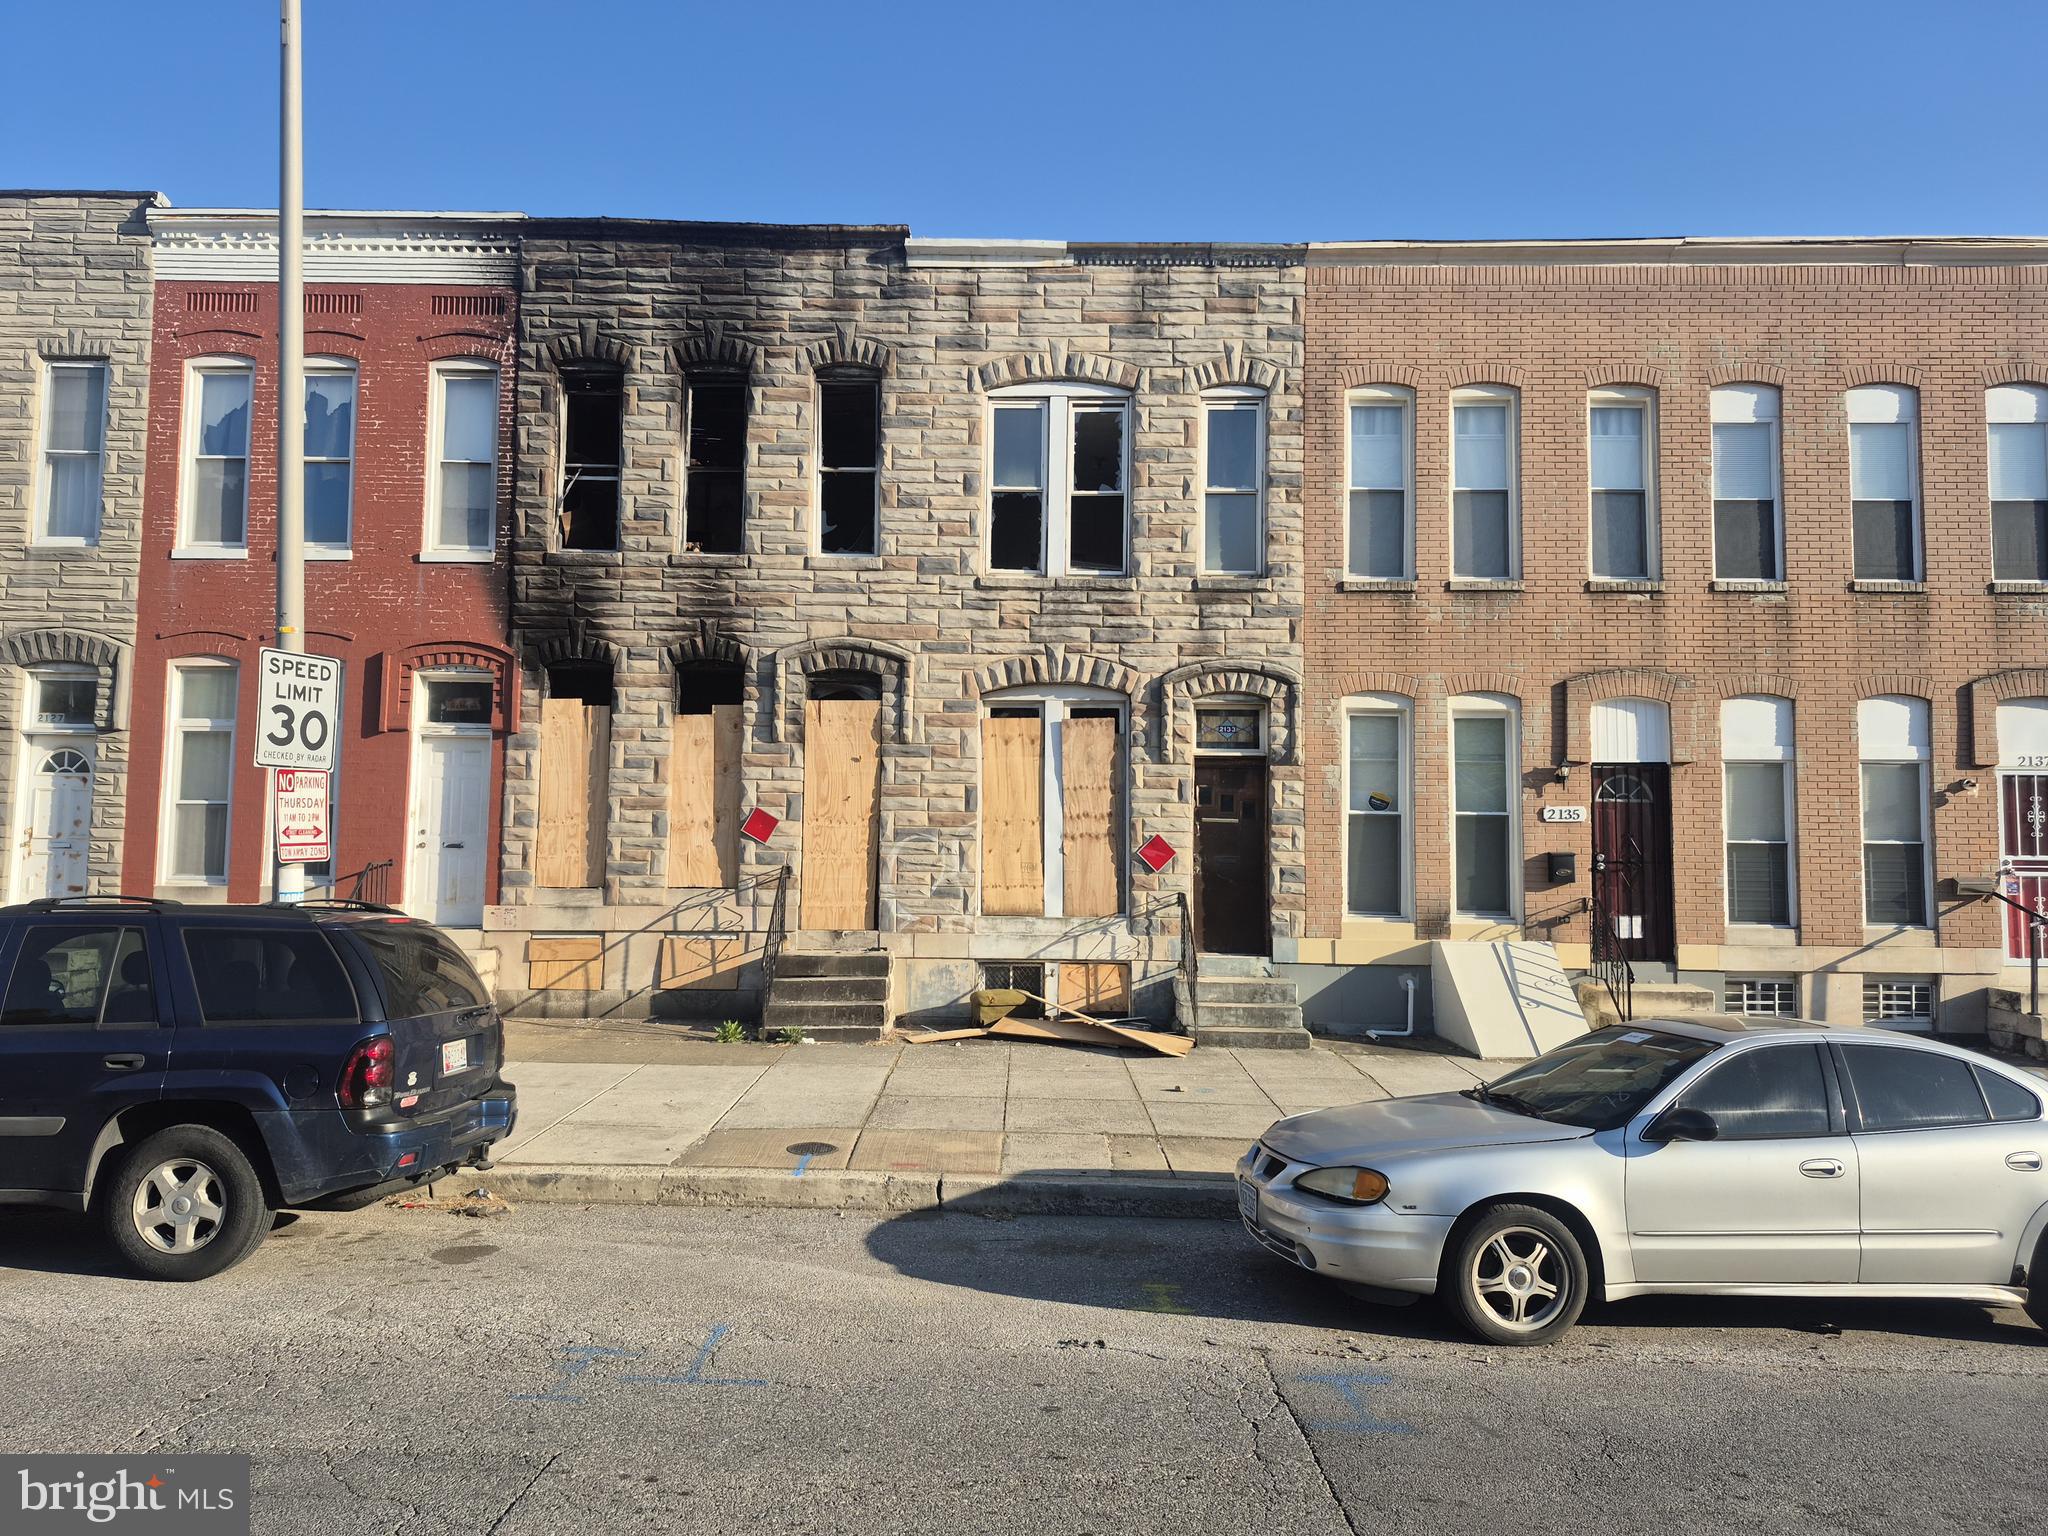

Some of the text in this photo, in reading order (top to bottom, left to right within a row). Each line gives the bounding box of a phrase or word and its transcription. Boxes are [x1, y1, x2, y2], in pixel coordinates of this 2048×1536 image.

[269, 657, 331, 681] SPEED
[276, 682, 323, 703] LIMIT
[38, 713, 65, 723] 2127
[266, 704, 328, 751] 30
[263, 750, 327, 763] CHECKED BY RADAR
[279, 773, 325, 792] NO PARKING
[280, 797, 324, 809] THURSDAY
[298, 813, 306, 822] TO
[1547, 809, 1580, 820] 2135
[310, 846, 326, 857] ZONE
